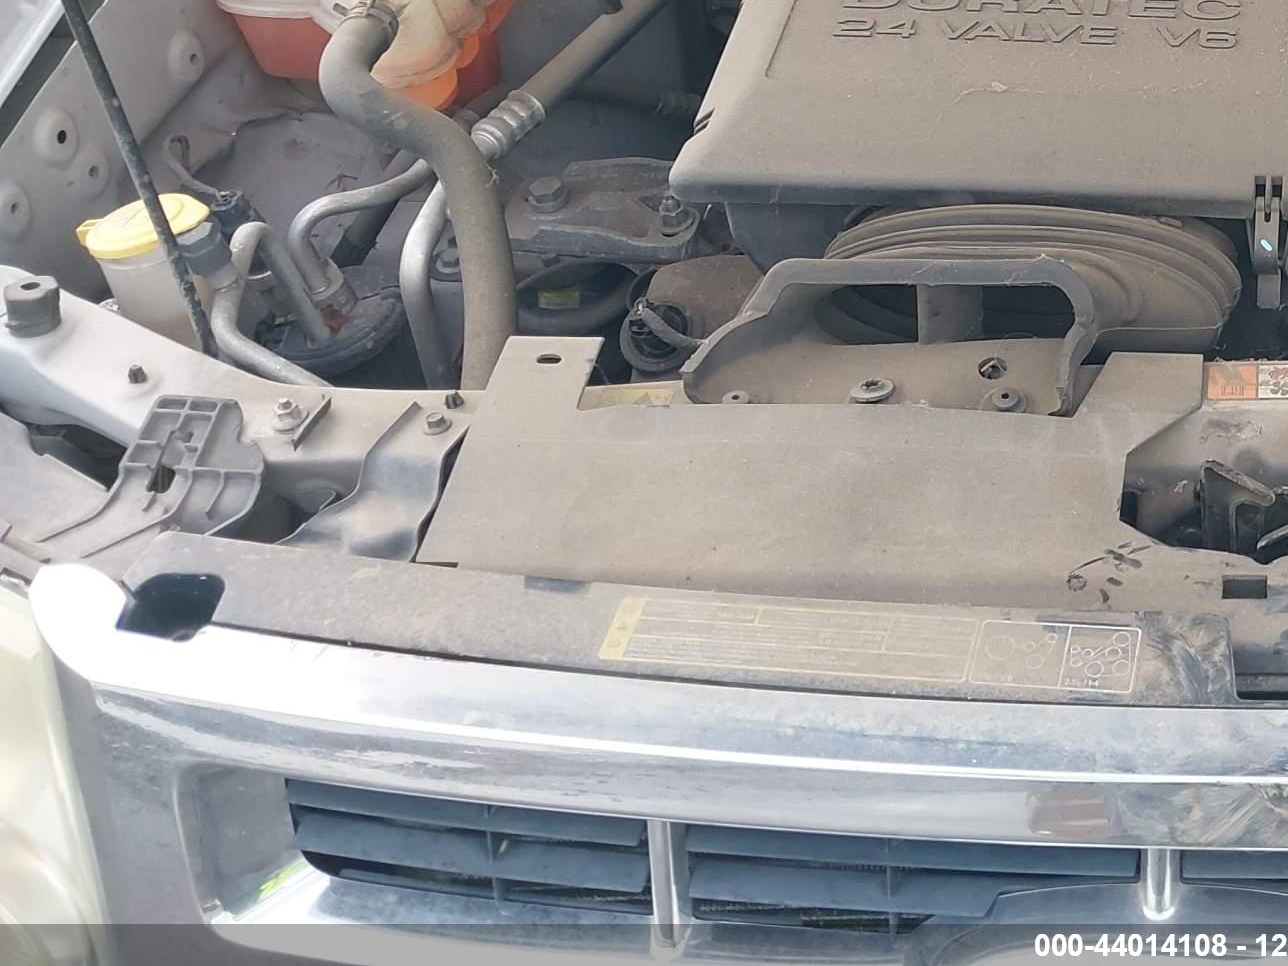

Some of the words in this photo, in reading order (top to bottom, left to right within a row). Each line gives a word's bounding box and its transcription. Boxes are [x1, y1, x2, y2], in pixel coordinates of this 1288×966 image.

[832, 18, 917, 40] 24
[942, 20, 1119, 46] VALVE
[1155, 25, 1239, 50] V6
